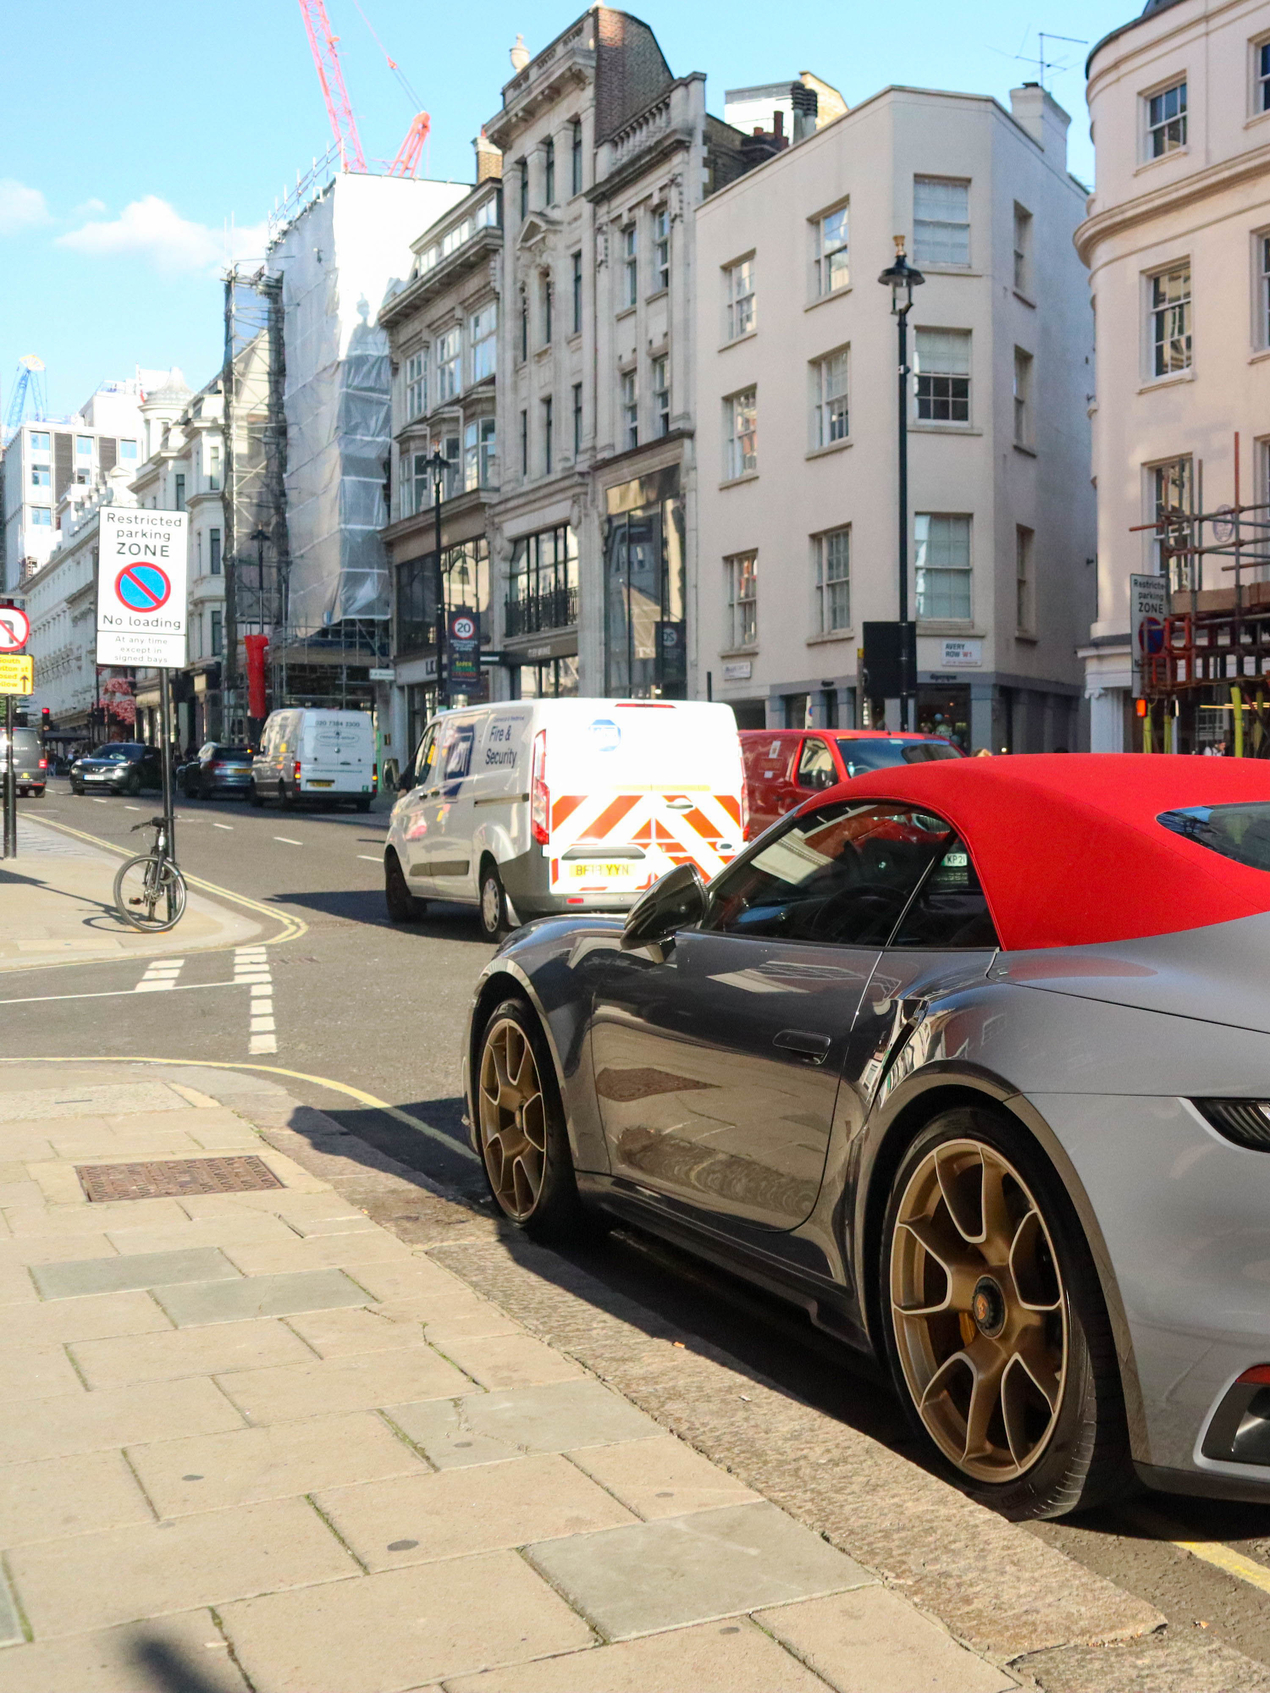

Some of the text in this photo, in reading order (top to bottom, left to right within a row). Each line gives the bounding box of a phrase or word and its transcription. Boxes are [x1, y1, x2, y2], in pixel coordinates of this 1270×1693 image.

[106, 512, 182, 527] Restricted
[116, 529, 170, 542] parking
[116, 542, 170, 558] ZONE
[1134, 578, 1166, 590] Restricte
[1138, 592, 1164, 602] parking
[1138, 602, 1164, 614] ZONE
[103, 614, 181, 630] No loading
[456, 622, 471, 633] 20
[489, 725, 511, 742] Fire &
[485, 748, 517, 768] Security
[606, 865, 629, 876] YYN
